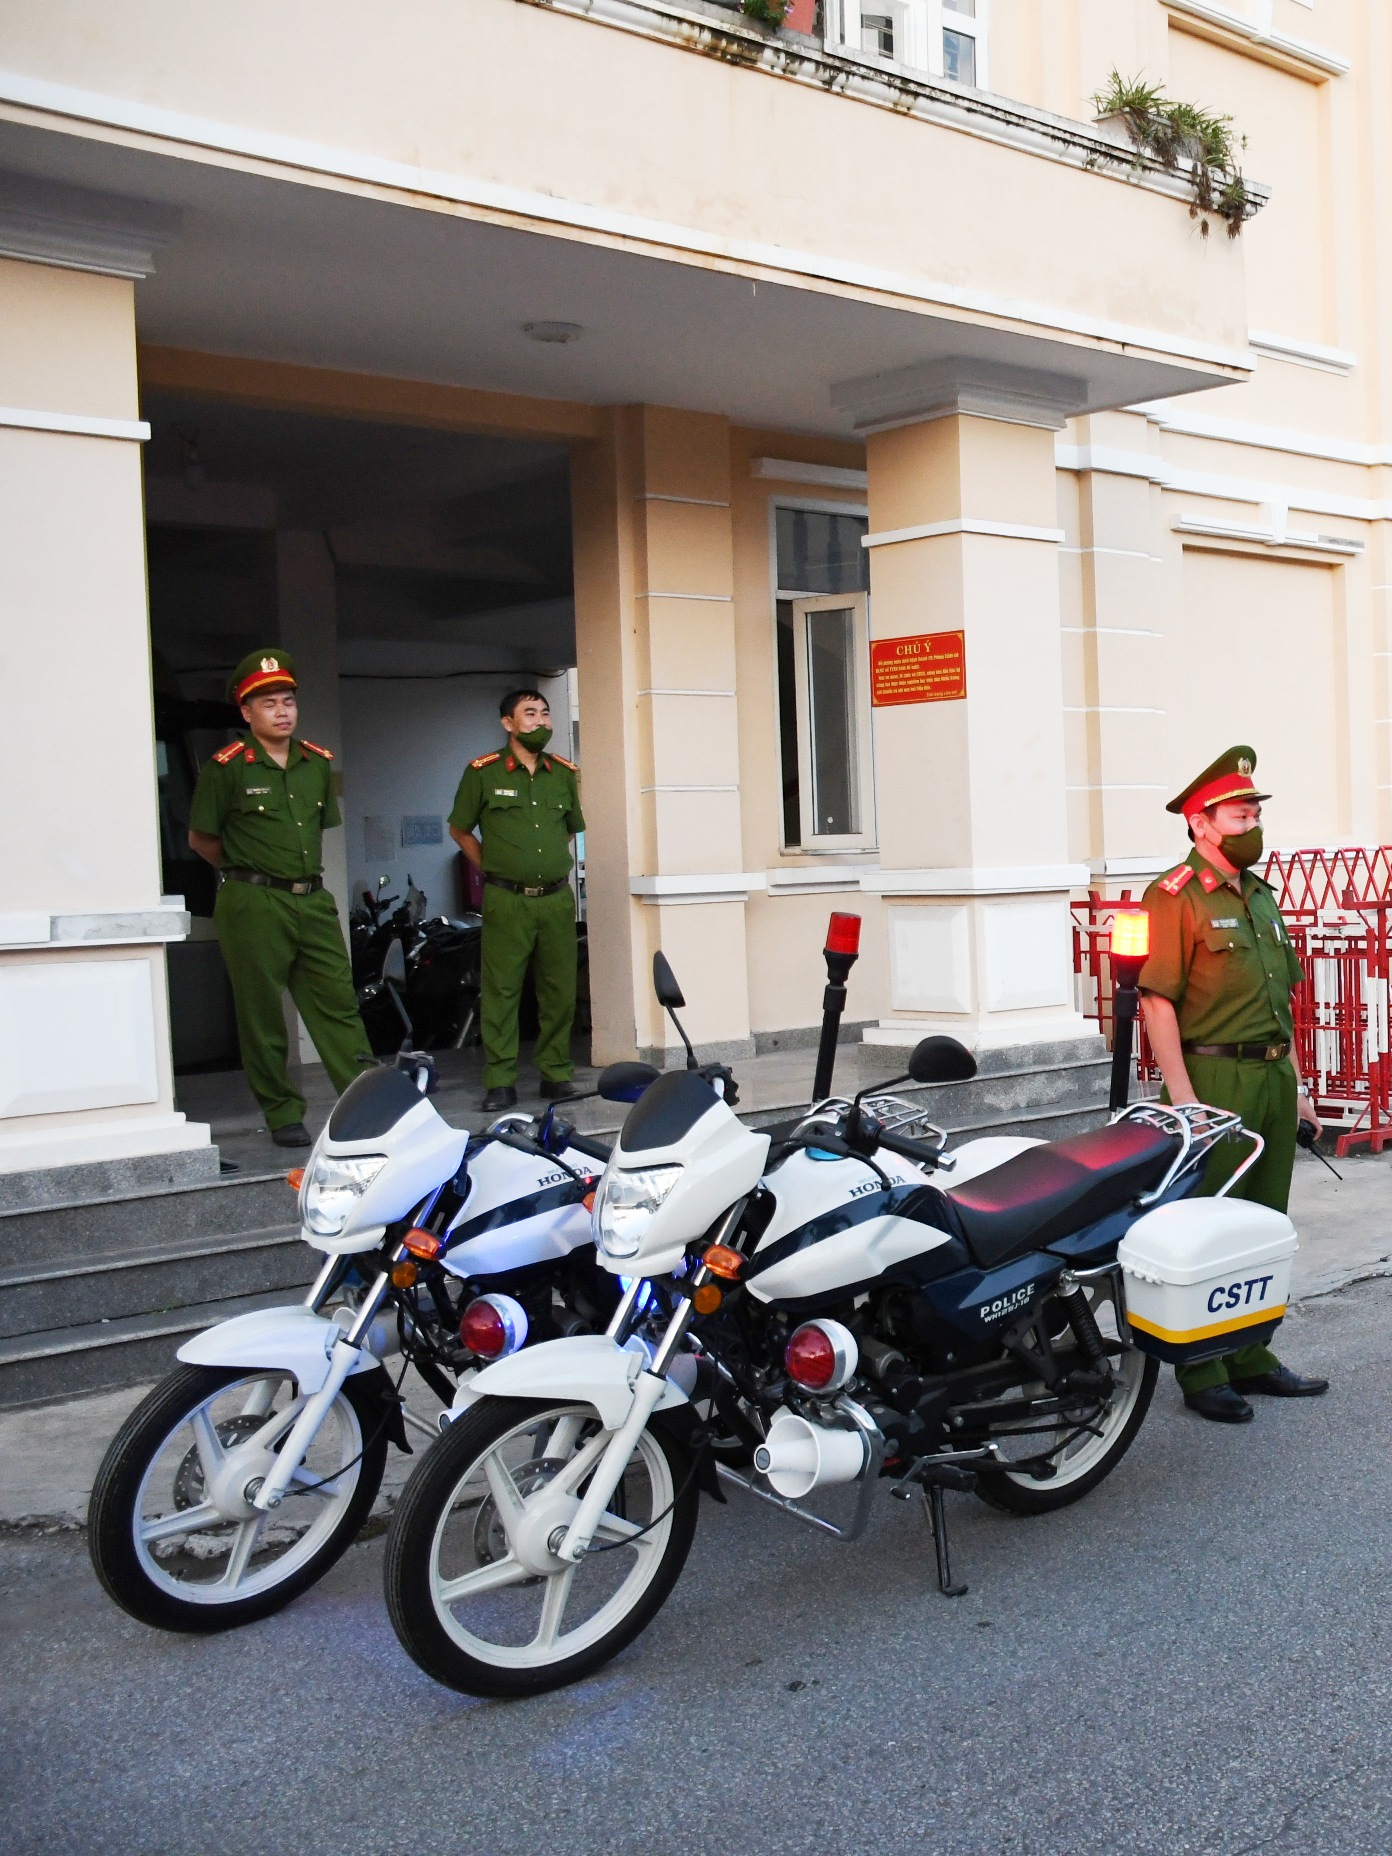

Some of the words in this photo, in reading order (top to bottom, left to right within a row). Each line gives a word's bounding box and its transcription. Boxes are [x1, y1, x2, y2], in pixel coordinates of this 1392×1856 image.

[896, 642, 921, 656] CHÚ
[923, 640, 932, 653] Ý
[980, 1283, 1035, 1318] POLICE
[1207, 1275, 1273, 1313] CSTT
